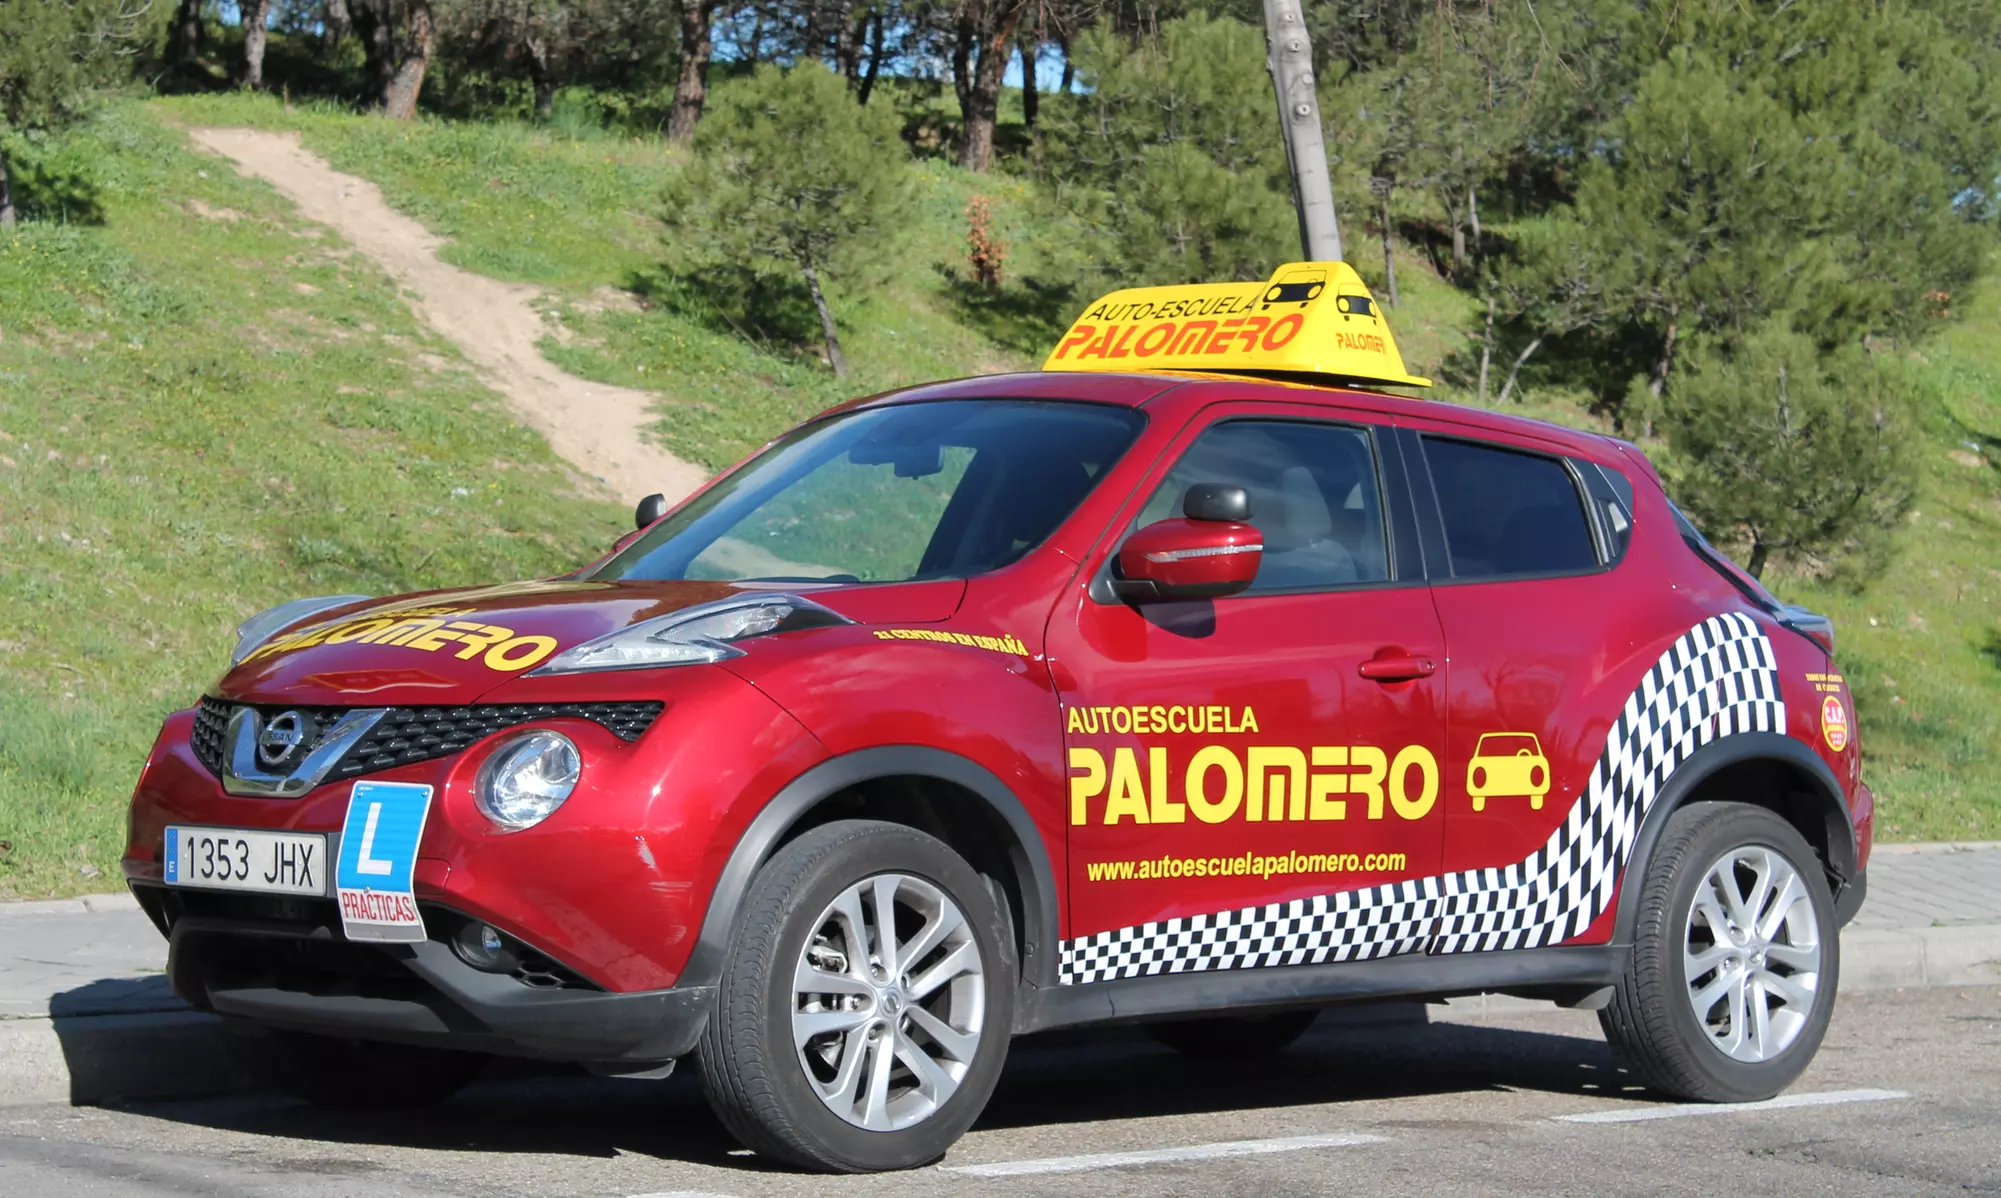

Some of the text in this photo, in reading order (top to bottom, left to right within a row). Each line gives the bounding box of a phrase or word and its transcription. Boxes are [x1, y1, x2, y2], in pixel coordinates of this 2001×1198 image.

[1088, 297, 1259, 321] AUTO-ESCUELA
[1055, 313, 1304, 359] PALOMERO
[1336, 332, 1386, 354] PALOMER
[890, 629, 957, 643] CENTROS
[953, 633, 976, 647] EN
[974, 634, 1029, 656] ESPAÑA
[1067, 705, 1259, 734] AUTOESCUELA
[1068, 744, 1440, 826] PALOMERO
[356, 802, 392, 875] L
[187, 837, 314, 887] 1353 JHX
[1087, 850, 1407, 881] www.autoescuelapalomero.com
